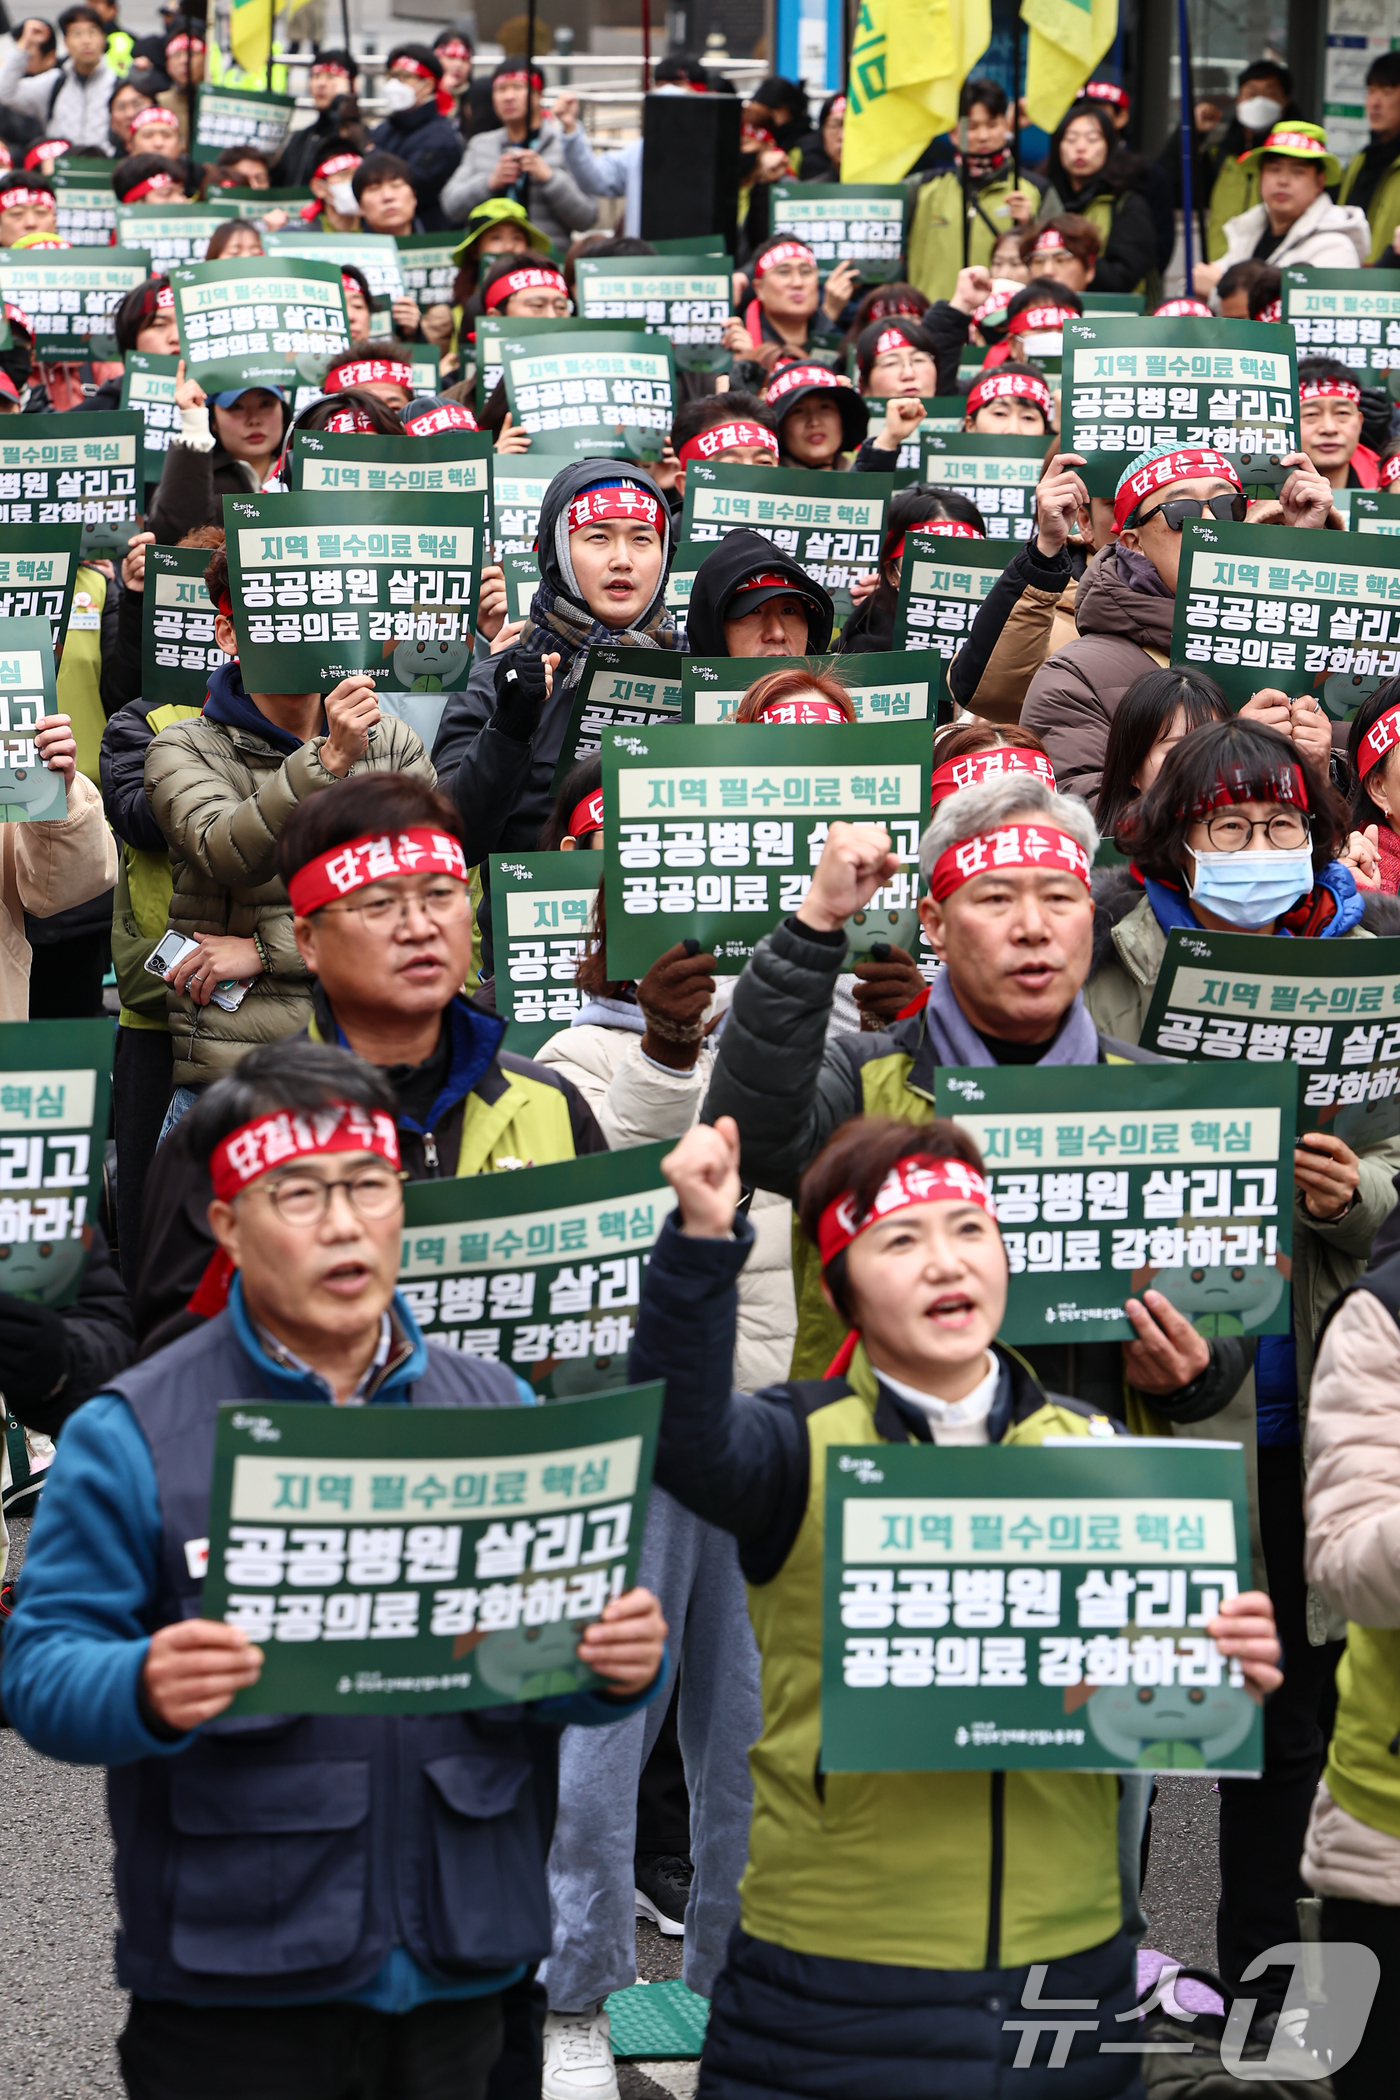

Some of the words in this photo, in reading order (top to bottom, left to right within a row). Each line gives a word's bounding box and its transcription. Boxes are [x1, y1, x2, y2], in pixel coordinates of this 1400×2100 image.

[197, 288, 228, 306] 지역
[234, 283, 297, 303] 필수의료
[303, 283, 329, 302] 핵심
[1305, 296, 1337, 312] 지역
[183, 304, 277, 340] 공공병원
[282, 305, 346, 333] 살리고
[669, 301, 730, 324] 살리고
[188, 332, 270, 363] 공공의료
[272, 331, 350, 355] 강화하라!
[1288, 318, 1381, 344] 공공병원
[527, 359, 560, 378] 지역
[564, 357, 624, 376] 필수의료
[630, 356, 657, 375] 핵심
[1094, 355, 1137, 377] 지역
[1145, 355, 1234, 378] 필수의료
[1239, 356, 1276, 382] 핵심
[514, 378, 608, 411] 공공병원
[611, 380, 672, 407] 살리고
[1071, 387, 1199, 420] 공공병원
[1207, 389, 1294, 425] 살리고
[128, 400, 181, 428] 공공
[520, 405, 600, 434] 공공의료
[601, 404, 673, 431] 강화하라!
[3, 445, 78, 464] 필수의료
[84, 443, 120, 461] 핵심
[697, 425, 740, 456] 단결
[1073, 424, 1178, 451] 공공의료
[1186, 425, 1296, 455] 강화하라!
[56, 468, 136, 498] 살리고
[321, 467, 360, 488] 지역
[367, 469, 443, 490] 필수의료
[448, 467, 477, 487] 핵심
[944, 462, 977, 479] 지역
[1131, 460, 1173, 497] 단결
[38, 500, 136, 523] 강화하라!
[568, 495, 594, 530] 결
[616, 491, 658, 523] 투쟁
[712, 496, 750, 518] 지역
[757, 501, 831, 524] 필수의료
[837, 505, 870, 525] 핵심
[261, 536, 309, 561] 지역
[316, 534, 412, 558] 필수의료
[418, 532, 457, 559] 핵심
[805, 532, 880, 562] 살리고
[16, 560, 53, 582] 핵심
[931, 570, 970, 593] 지역
[1212, 562, 1259, 589] 지역
[1268, 567, 1359, 598] 필수의료
[240, 569, 379, 608] 공공병원
[387, 569, 471, 605] 살리고
[153, 610, 215, 642] 공공
[247, 610, 361, 644] 공공의료
[368, 610, 468, 643] 강화하라!
[1185, 594, 1321, 638] 공공병원
[1184, 632, 1297, 671] 공공의료
[609, 678, 656, 703] 지역
[870, 692, 911, 716] 핵심
[647, 779, 707, 808] 지역
[719, 777, 841, 807] 필수의료
[850, 776, 901, 805] 핵심
[618, 821, 794, 869] 공공병원
[956, 827, 1024, 878] 단결
[325, 836, 400, 894] 단결
[622, 875, 769, 914] 공공의료
[533, 899, 588, 928] 지역
[1197, 979, 1261, 1010] 지역
[1270, 985, 1385, 1014] 필수의료
[1156, 1012, 1333, 1066] 공공병원
[0, 1084, 65, 1119] 핵심
[226, 1112, 298, 1180] 단결
[983, 1126, 1044, 1158] 지역
[1056, 1123, 1180, 1156] 필수의료
[1191, 1120, 1252, 1153] 핵심
[985, 1170, 1130, 1224] 공병원
[1141, 1168, 1278, 1219] 살리고
[459, 1218, 589, 1264] 필수의료
[597, 1204, 655, 1242] 핵심
[1001, 1230, 1102, 1274] 공의료
[1111, 1225, 1278, 1271] 강화하라!
[549, 1255, 650, 1315] 살리
[273, 1473, 354, 1510] 지역
[369, 1470, 530, 1511] 필수의료
[541, 1458, 609, 1496] 핵심
[224, 1525, 463, 1586] 공공병원
[475, 1502, 633, 1580] 살리고
[880, 1514, 953, 1551] 지역
[969, 1514, 1122, 1552] 필수의료
[1136, 1512, 1206, 1551] 핵심
[224, 1591, 420, 1643] 공공의료
[430, 1564, 626, 1637] 강화하라!
[839, 1568, 1061, 1628] 공공병원
[1075, 1569, 1240, 1629] 살리고
[842, 1637, 1027, 1688] 공공의료
[1038, 1635, 1246, 1688] 강화하라!
